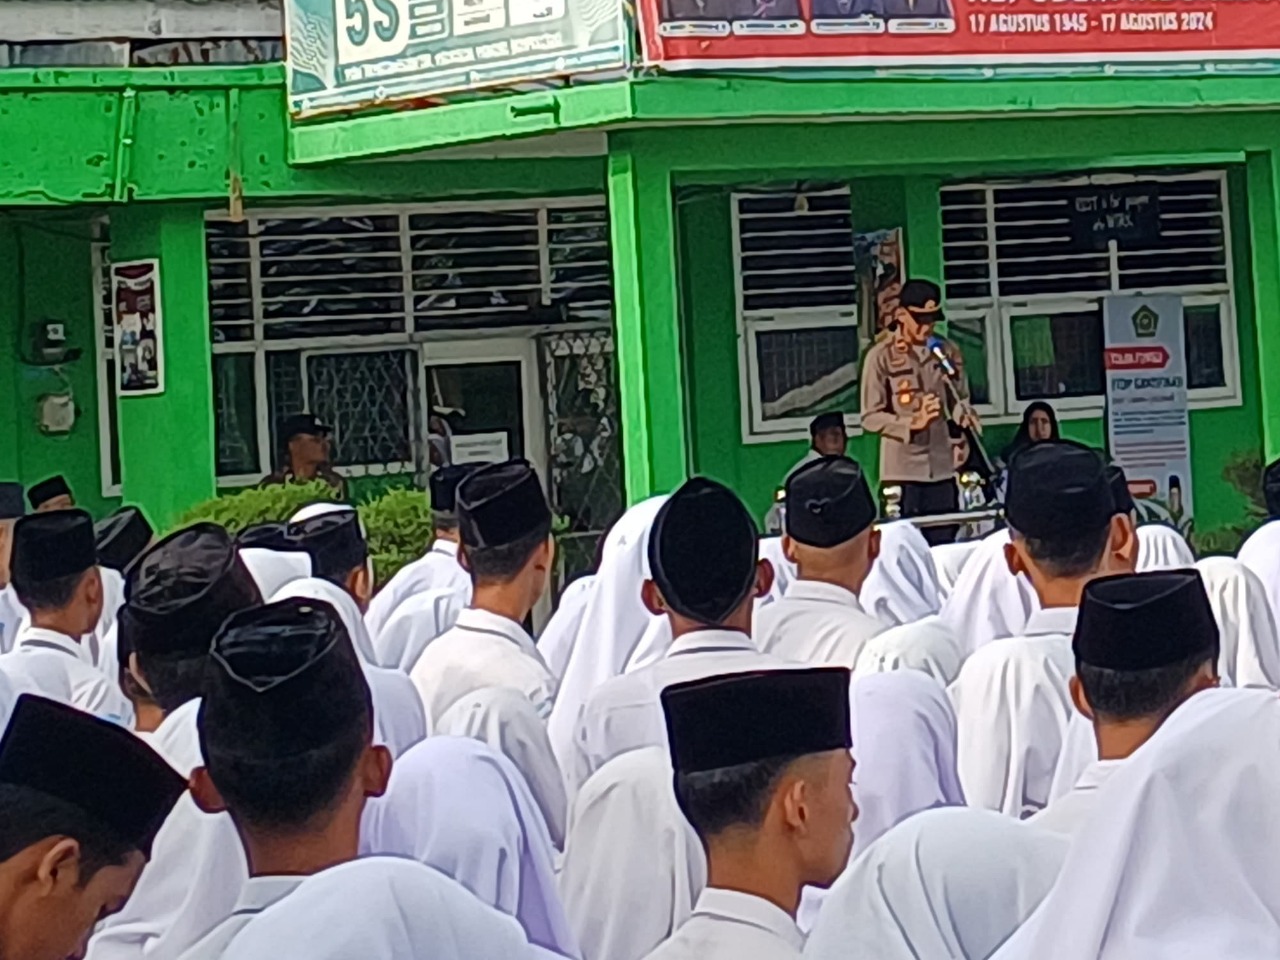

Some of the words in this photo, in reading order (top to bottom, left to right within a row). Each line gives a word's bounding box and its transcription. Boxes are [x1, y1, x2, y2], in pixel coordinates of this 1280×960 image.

[969, 14, 986, 33] 17
[988, 13, 1051, 33] AGUSTUS
[1053, 13, 1089, 33] 1945
[1101, 13, 1117, 32] 17
[1119, 12, 1178, 31] AGUSTUS
[1180, 11, 1214, 31] 2024
